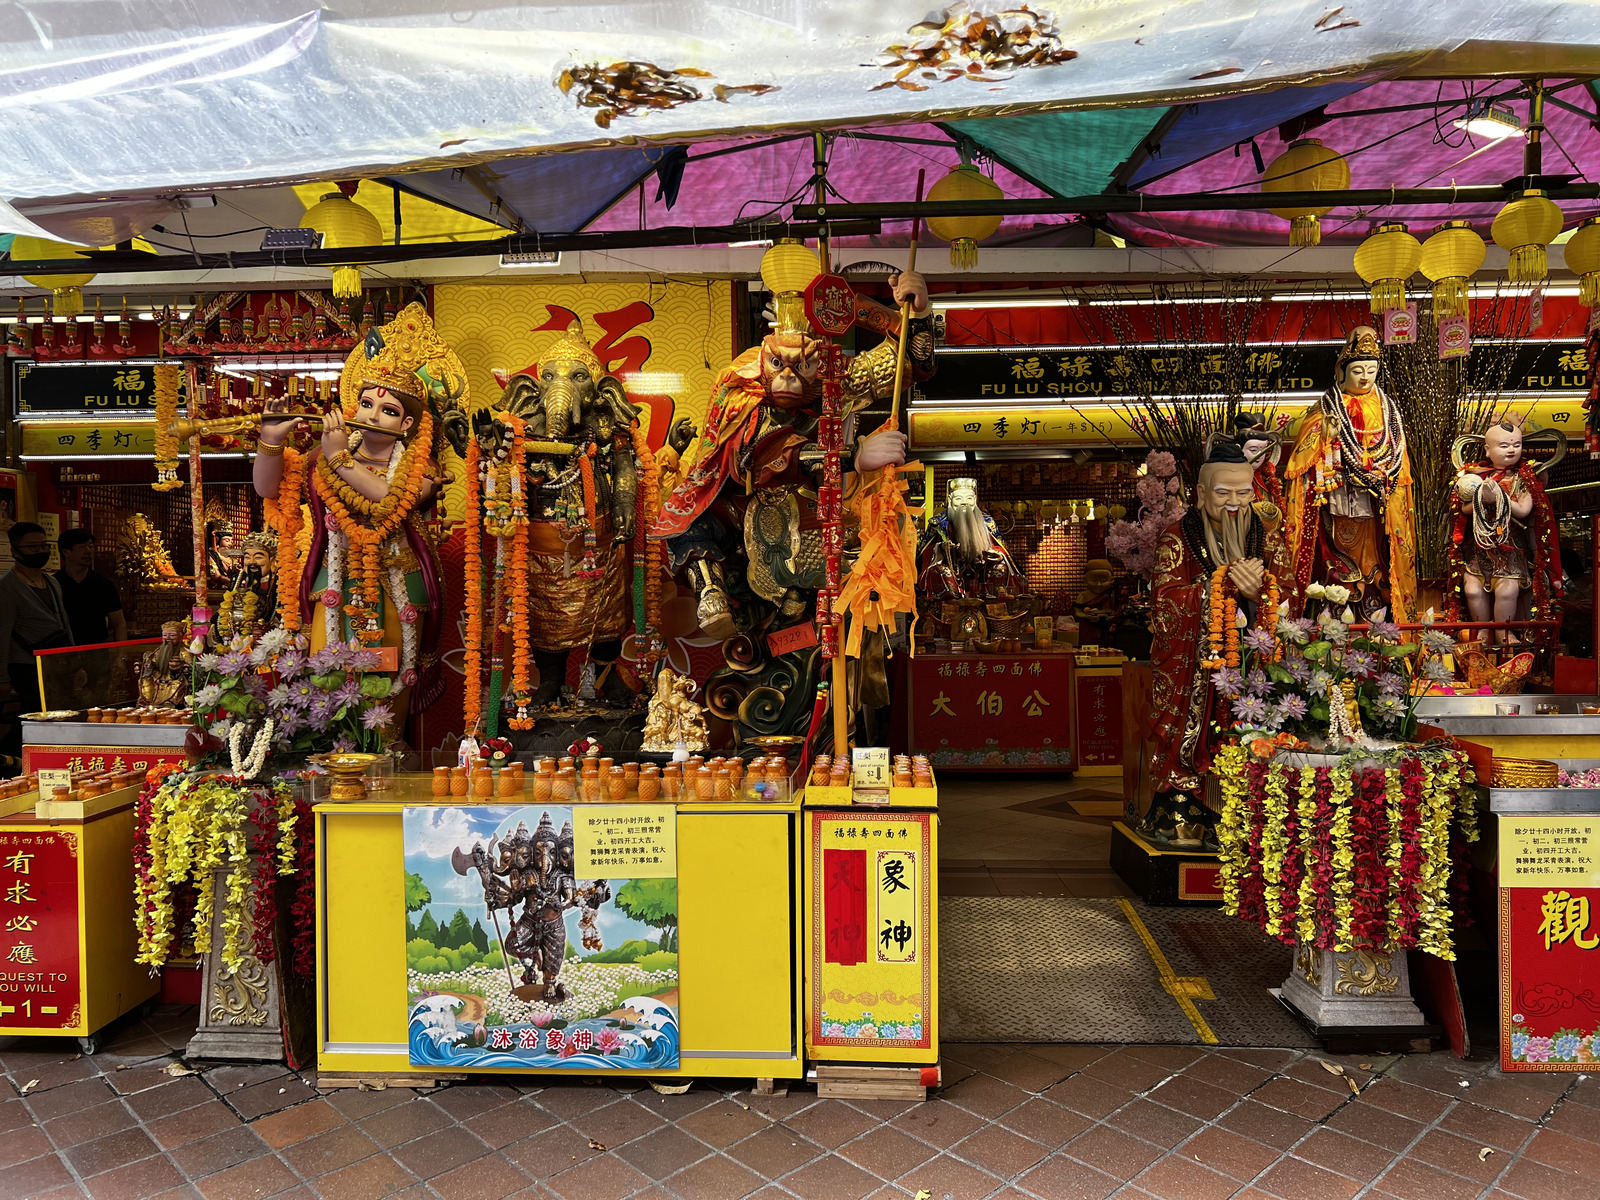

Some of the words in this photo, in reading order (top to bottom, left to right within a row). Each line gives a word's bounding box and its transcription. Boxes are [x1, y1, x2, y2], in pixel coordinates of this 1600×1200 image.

[1558, 349, 1590, 371] 福
[981, 383, 1006, 395] FU
[1014, 383, 1039, 395] LU
[1047, 381, 1103, 394] SHOU
[1277, 377, 1314, 390] LTD
[1527, 376, 1553, 387] FU
[1561, 375, 1586, 386] LU
[84, 395, 108, 406] FU
[116, 395, 140, 406] LU
[929, 689, 1051, 717] 大伯公
[3, 850, 38, 965] 有求必應
[880, 859, 912, 953] 象神
[1537, 890, 1600, 951] 觀
[0, 972, 44, 982] QUEST
[49, 973, 68, 982] TO
[0, 983, 19, 992] OU
[24, 984, 56, 993] WILL
[21, 999, 31, 1018] 1
[492, 1027, 593, 1050] 沐浴象神
